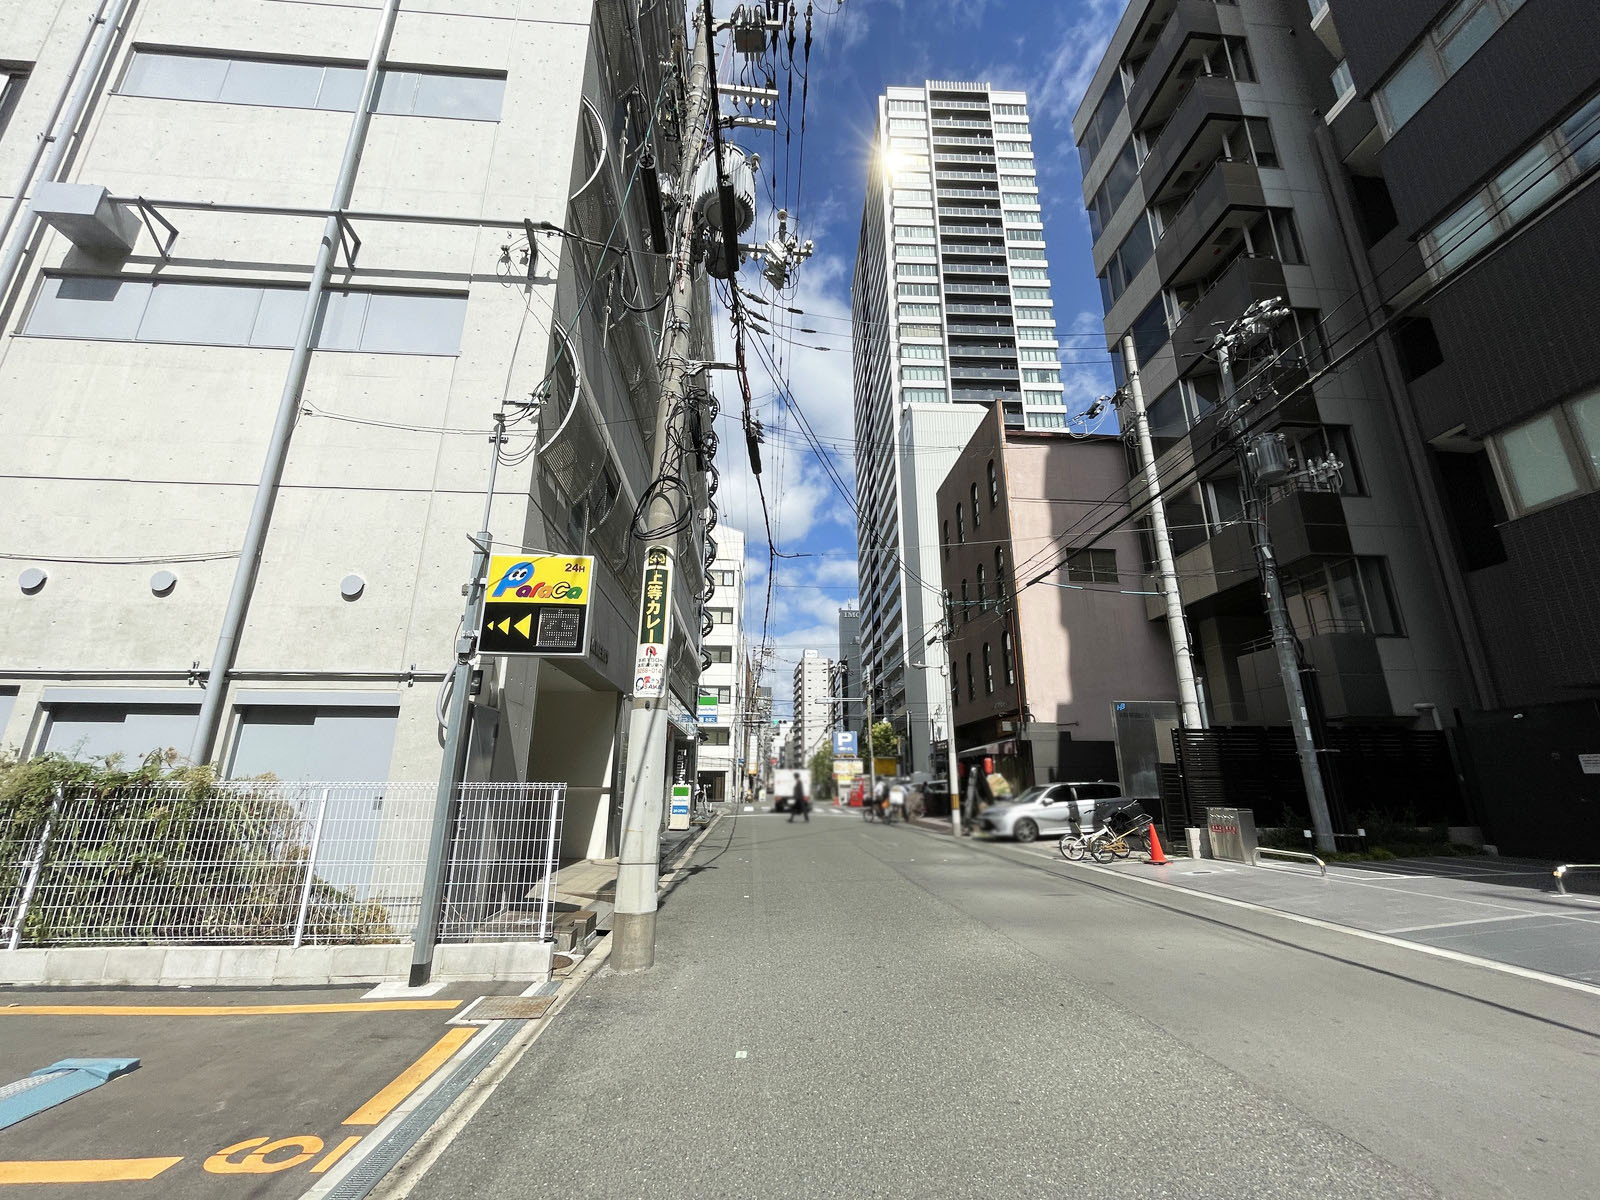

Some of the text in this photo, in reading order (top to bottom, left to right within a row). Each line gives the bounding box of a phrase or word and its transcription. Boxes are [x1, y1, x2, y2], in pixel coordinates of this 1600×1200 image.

[565, 563, 585, 573] 24H
[646, 571, 663, 643] 上等カレー
[837, 732, 853, 746] P
